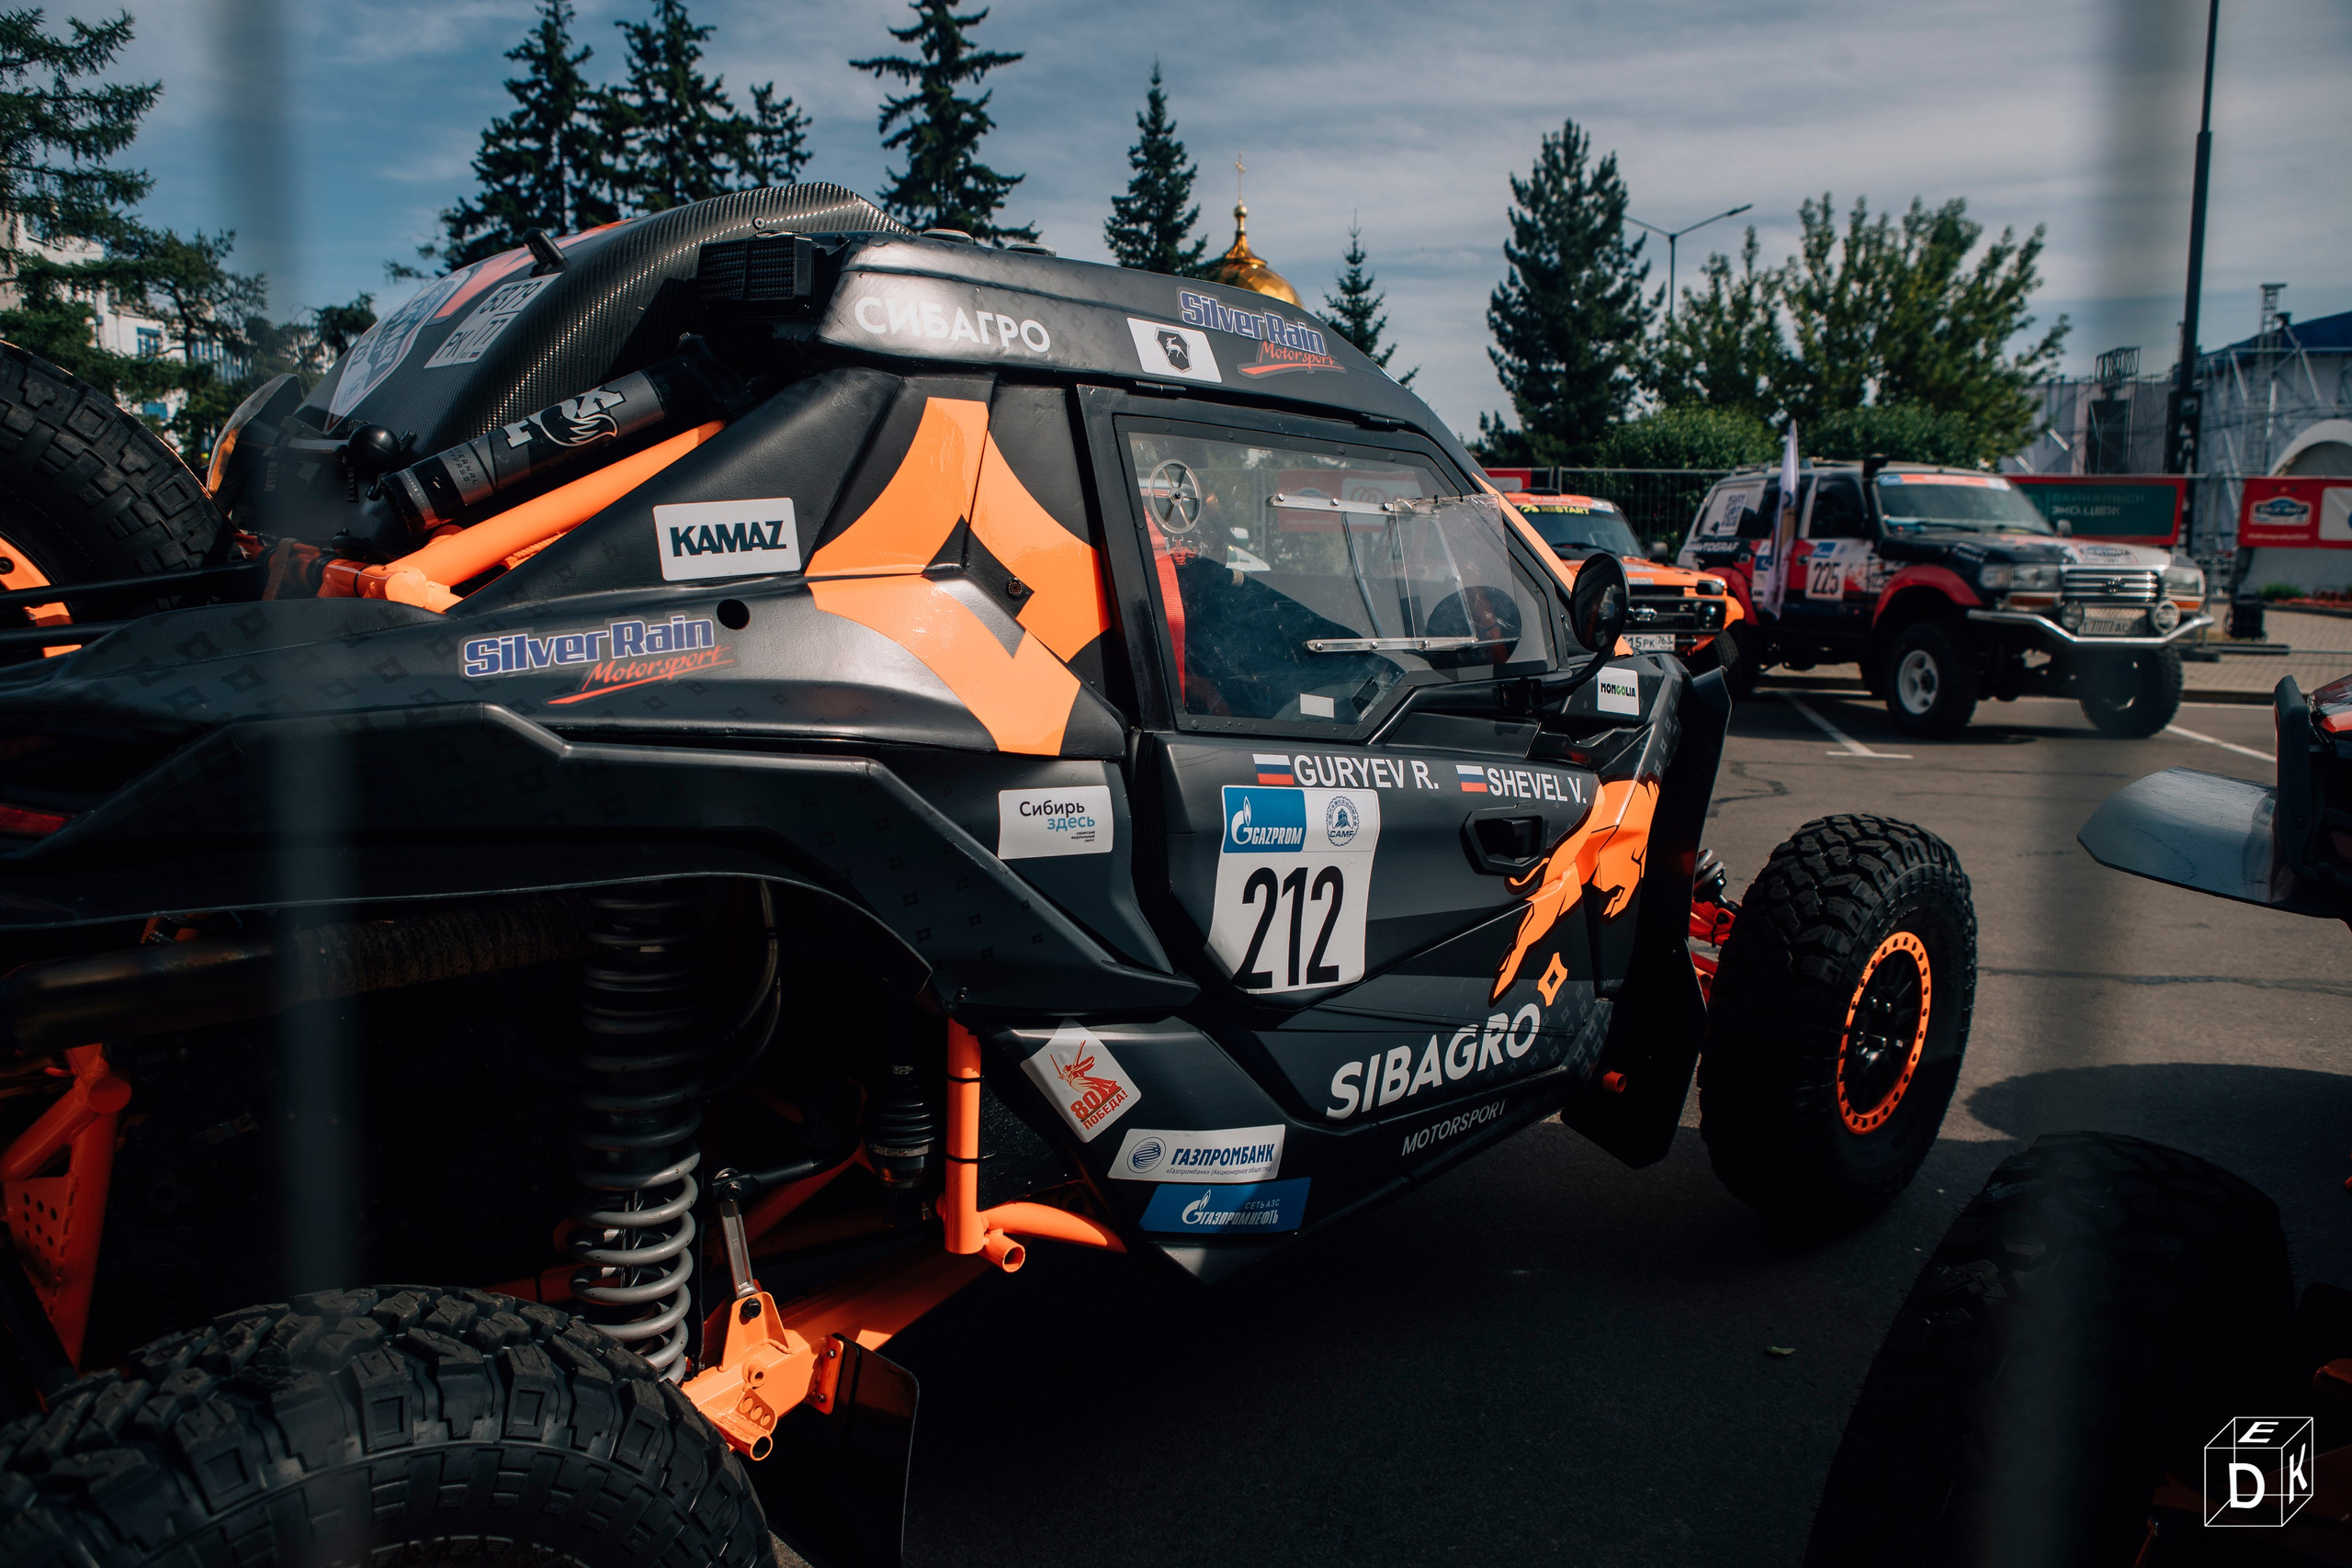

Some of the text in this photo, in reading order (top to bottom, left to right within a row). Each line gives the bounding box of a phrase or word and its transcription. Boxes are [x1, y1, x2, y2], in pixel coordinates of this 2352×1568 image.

[479, 281, 543, 314] 5379
[435, 318, 510, 359] PK 77
[854, 297, 1051, 354] СИБАГРО
[503, 386, 625, 447] FOX
[670, 520, 787, 558] KAMAZ
[1812, 561, 1841, 594] 225
[582, 645, 729, 691] Motorsport
[1600, 682, 1636, 698] MONGOLIA
[1294, 754, 1440, 790] GURYEV R.
[1487, 767, 1587, 804] SHEVEL V.
[1019, 799, 1085, 818] Сибирь
[1047, 816, 1095, 832] здесь
[1251, 827, 1303, 845] GAZPROM
[1230, 865, 1344, 989] 212
[1326, 1002, 1541, 1120] SIBAGRO
[1070, 1090, 1100, 1119] 80
[1082, 1089, 1128, 1130] ПОБЕДА!
[1401, 1098, 1508, 1156] MOTORSPORT
[1170, 1143, 1275, 1166] ГАЗПРОМБАНК
[1200, 1209, 1279, 1225] ГАЗПРОМНЕФТЬ
[1244, 1199, 1281, 1210] СЕТЬ АЗС
